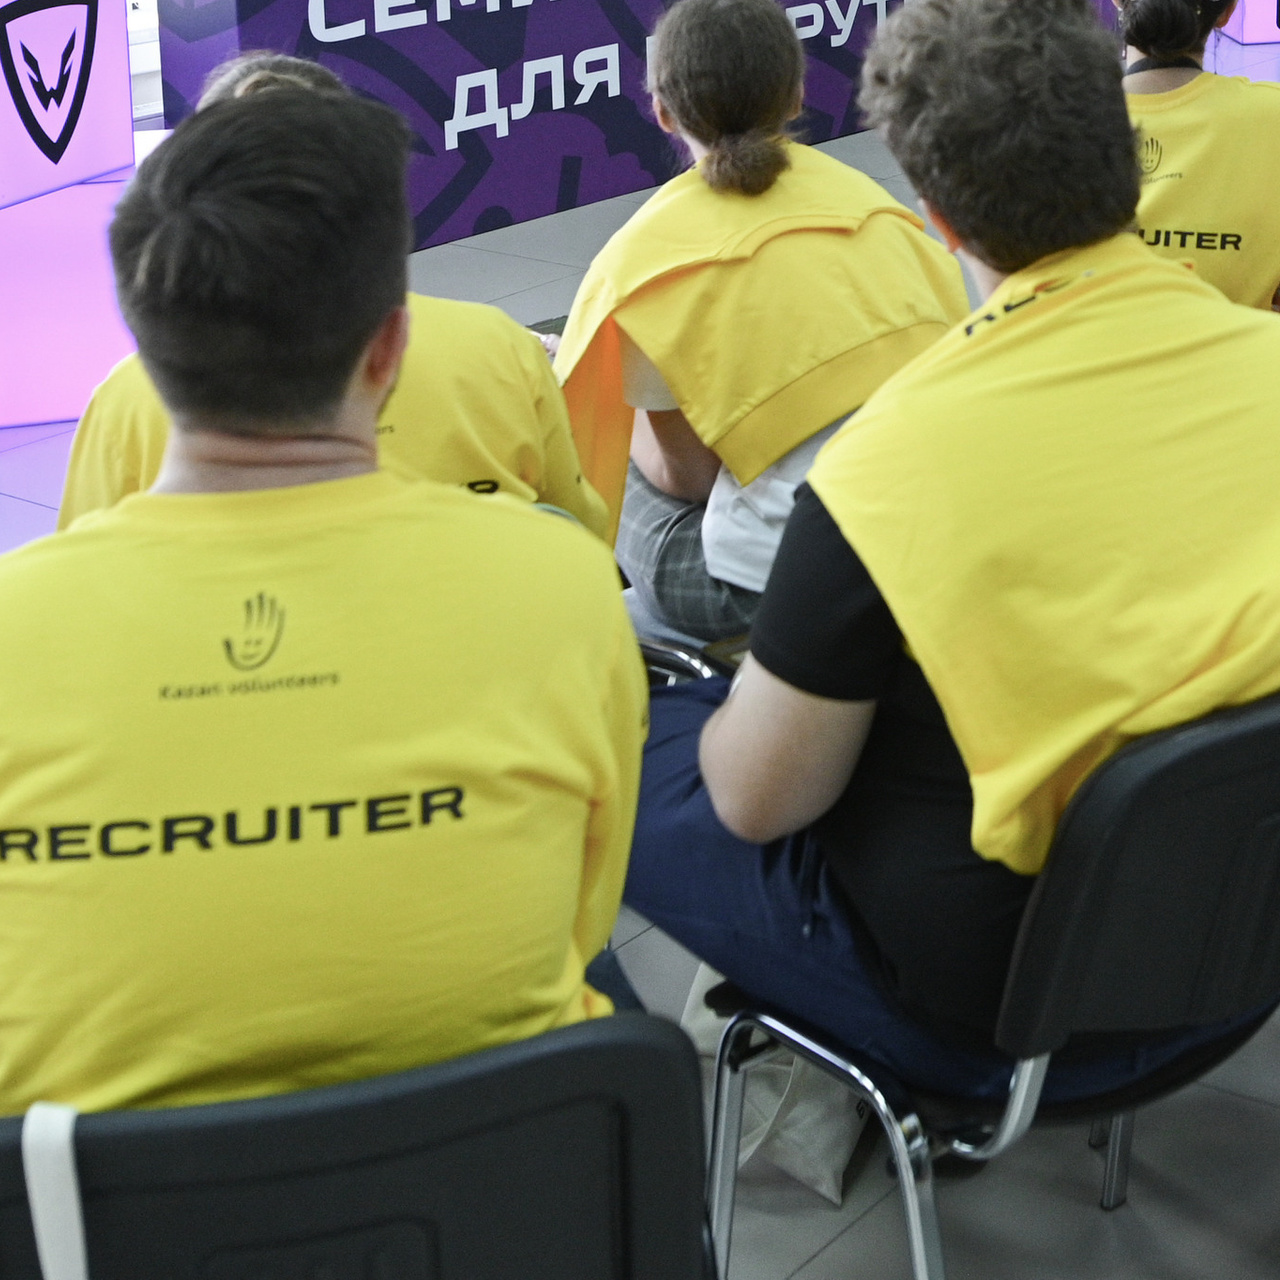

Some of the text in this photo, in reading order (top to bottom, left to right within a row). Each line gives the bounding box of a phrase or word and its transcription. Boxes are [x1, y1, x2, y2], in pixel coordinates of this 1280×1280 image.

[444, 43, 621, 150] ДЛЯ
[1144, 172, 1183, 184] olunteers
[1138, 229, 1242, 250] UITER
[158, 671, 340, 700] Kazan volunteers
[0, 785, 465, 862] RECRUITER
